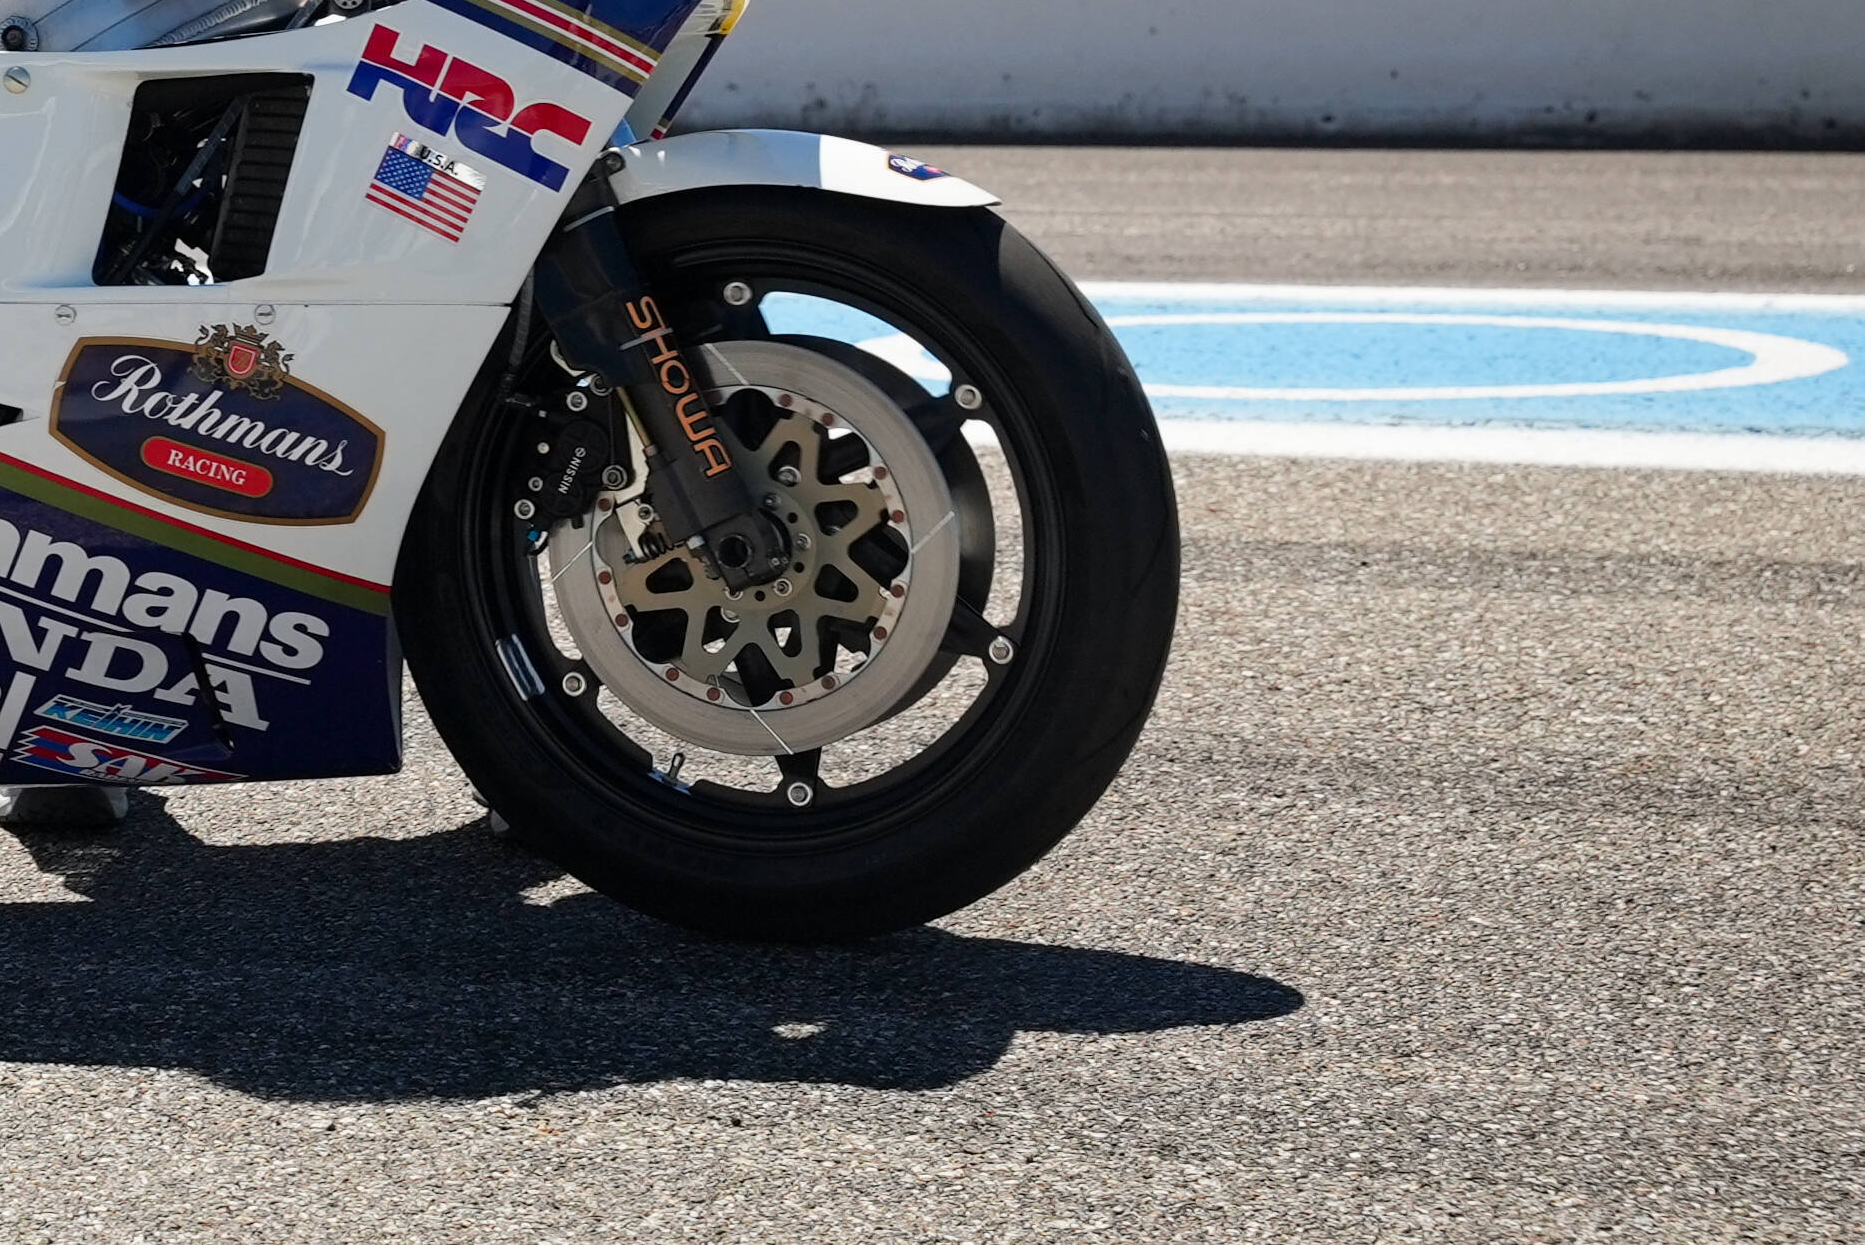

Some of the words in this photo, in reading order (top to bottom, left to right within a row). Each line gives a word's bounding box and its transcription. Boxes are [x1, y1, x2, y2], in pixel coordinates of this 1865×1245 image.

[345, 22, 593, 193] HRC
[419, 144, 459, 176] U.S.A.
[625, 294, 733, 480] SHOWA
[90, 354, 354, 478] Rothmans
[165, 448, 248, 486] RACING
[557, 456, 582, 495] NISSIN
[43, 701, 182, 742] KEIHIN
